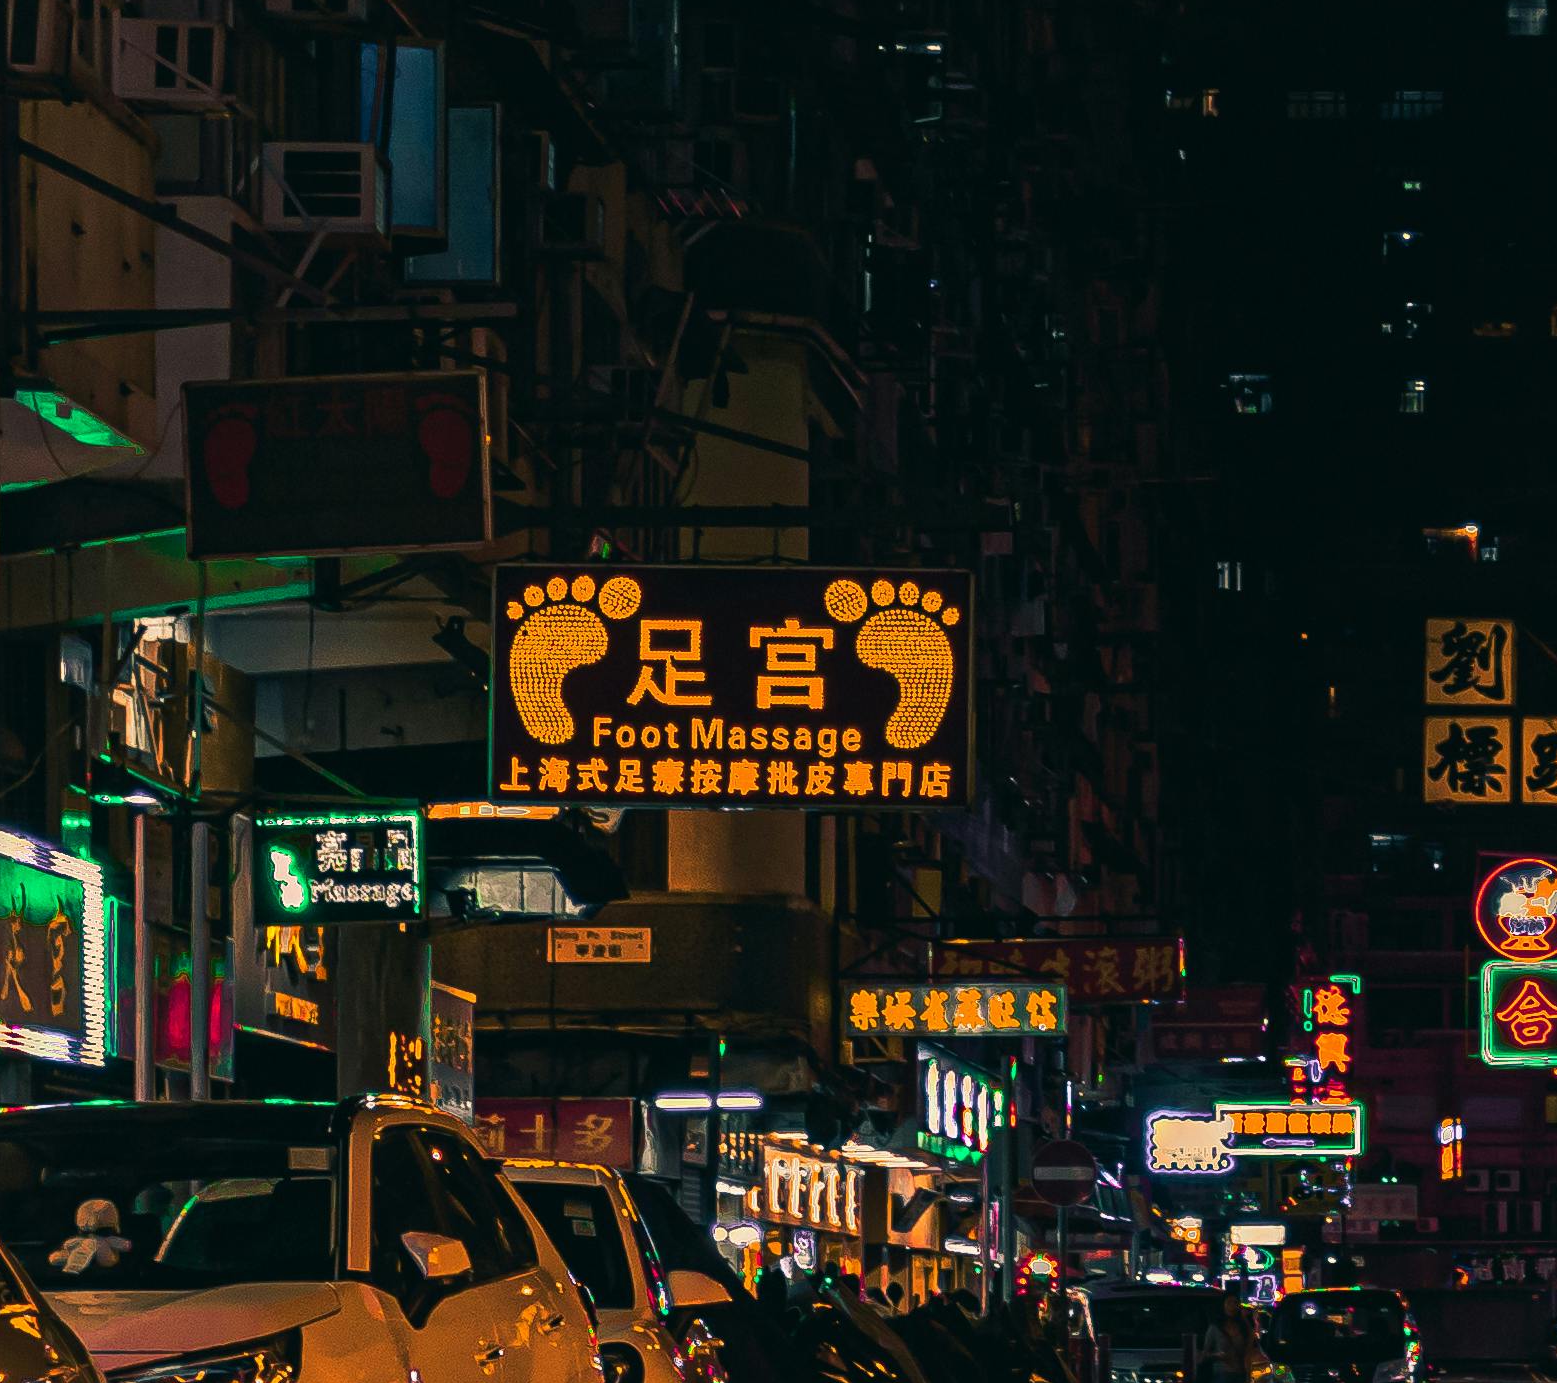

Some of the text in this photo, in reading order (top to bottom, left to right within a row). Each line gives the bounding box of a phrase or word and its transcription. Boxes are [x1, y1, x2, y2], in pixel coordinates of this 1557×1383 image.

[1429, 622, 1508, 700] 劉
[593, 717, 863, 758] Foot Massage
